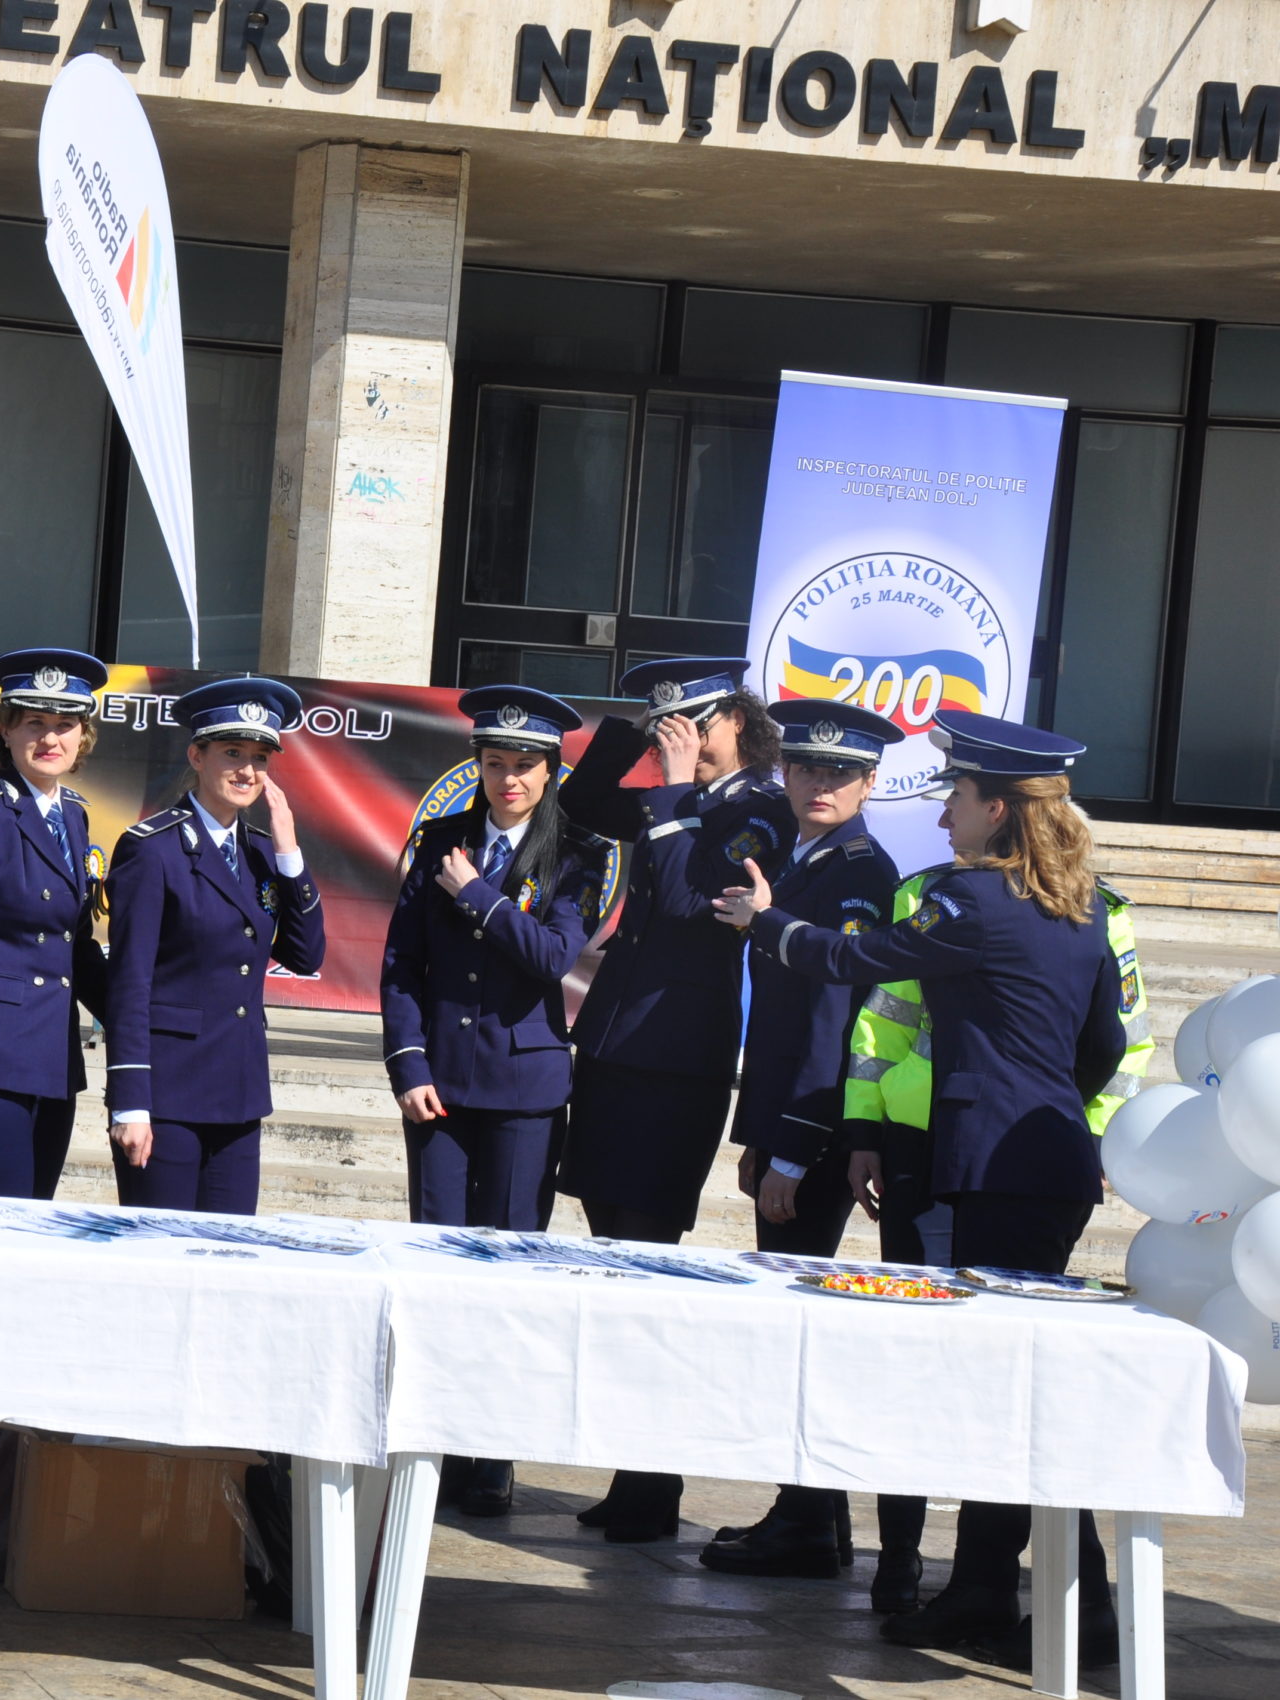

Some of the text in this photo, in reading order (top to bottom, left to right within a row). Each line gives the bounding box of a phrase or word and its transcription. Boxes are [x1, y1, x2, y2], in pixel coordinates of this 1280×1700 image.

[796, 457, 933, 484] INSPECTORATUL
[937, 471, 961, 486] DE
[934, 489, 979, 507] DOLJ
[850, 589, 945, 618] 25 MARTIE
[903, 560, 1005, 649] ROMÂNĂ
[829, 656, 944, 727] 200
